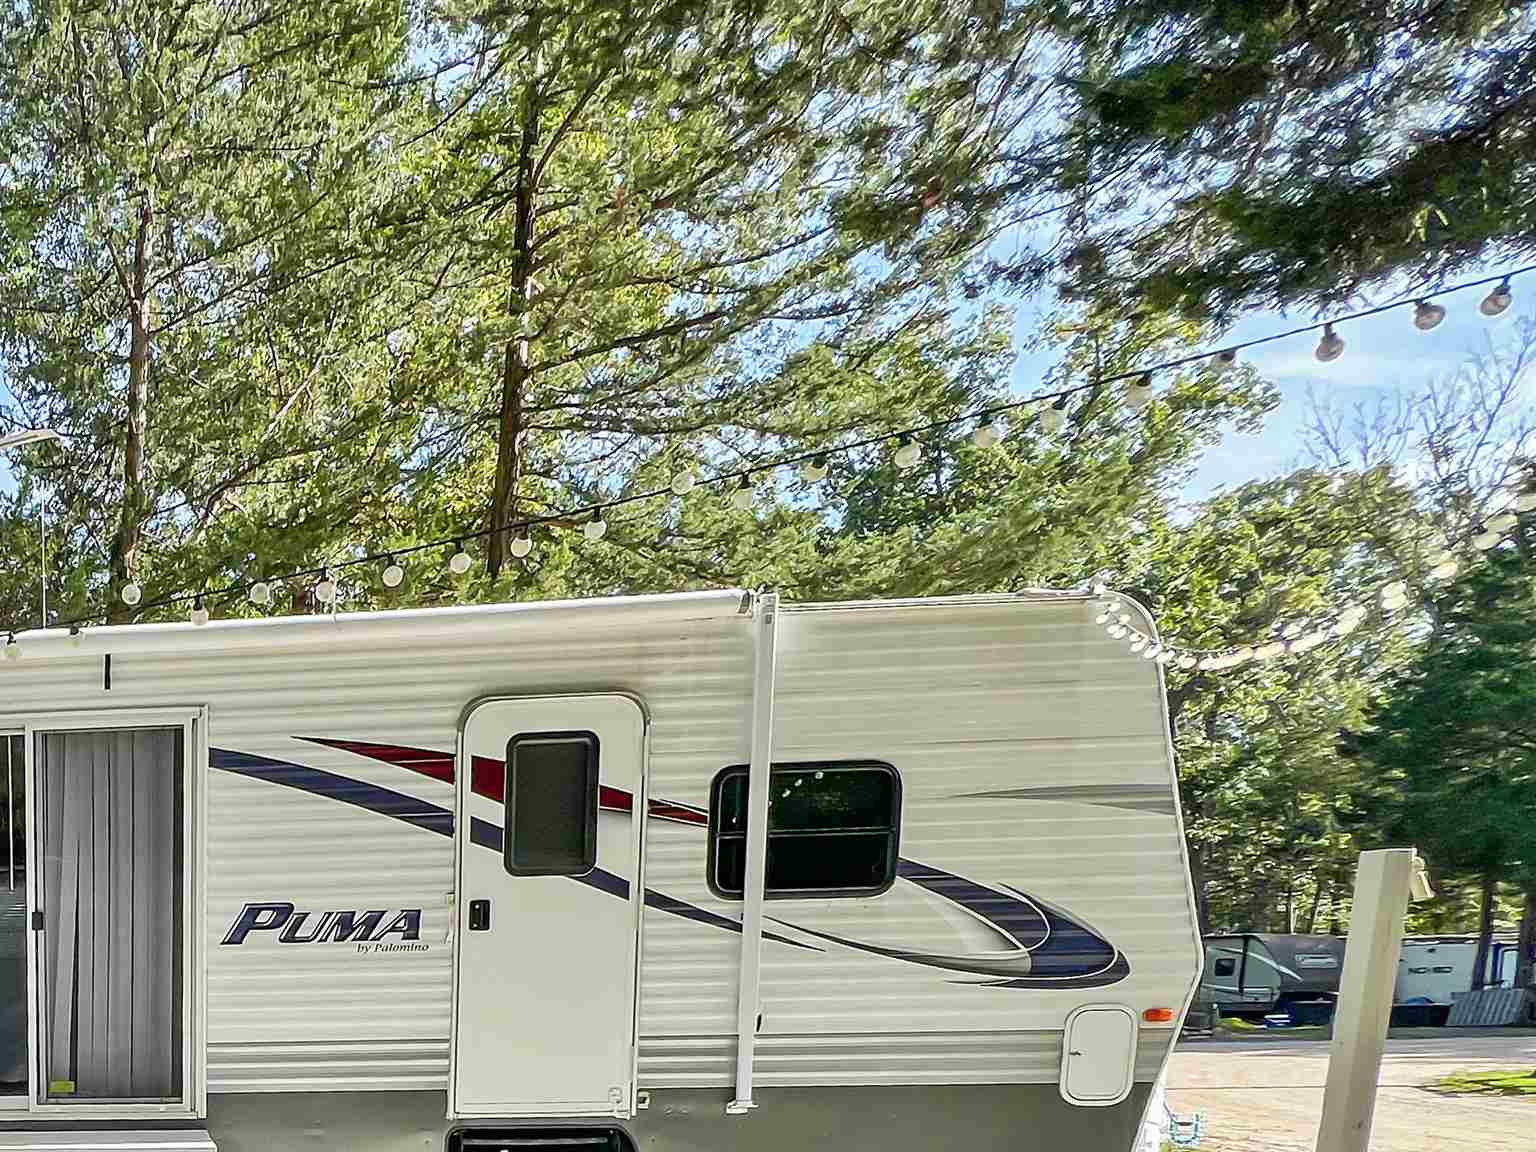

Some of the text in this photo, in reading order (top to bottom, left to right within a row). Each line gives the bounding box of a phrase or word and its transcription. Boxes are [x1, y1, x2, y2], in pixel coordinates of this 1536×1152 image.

[220, 901, 422, 945] PUMA
[356, 943, 430, 953] by Palomino
